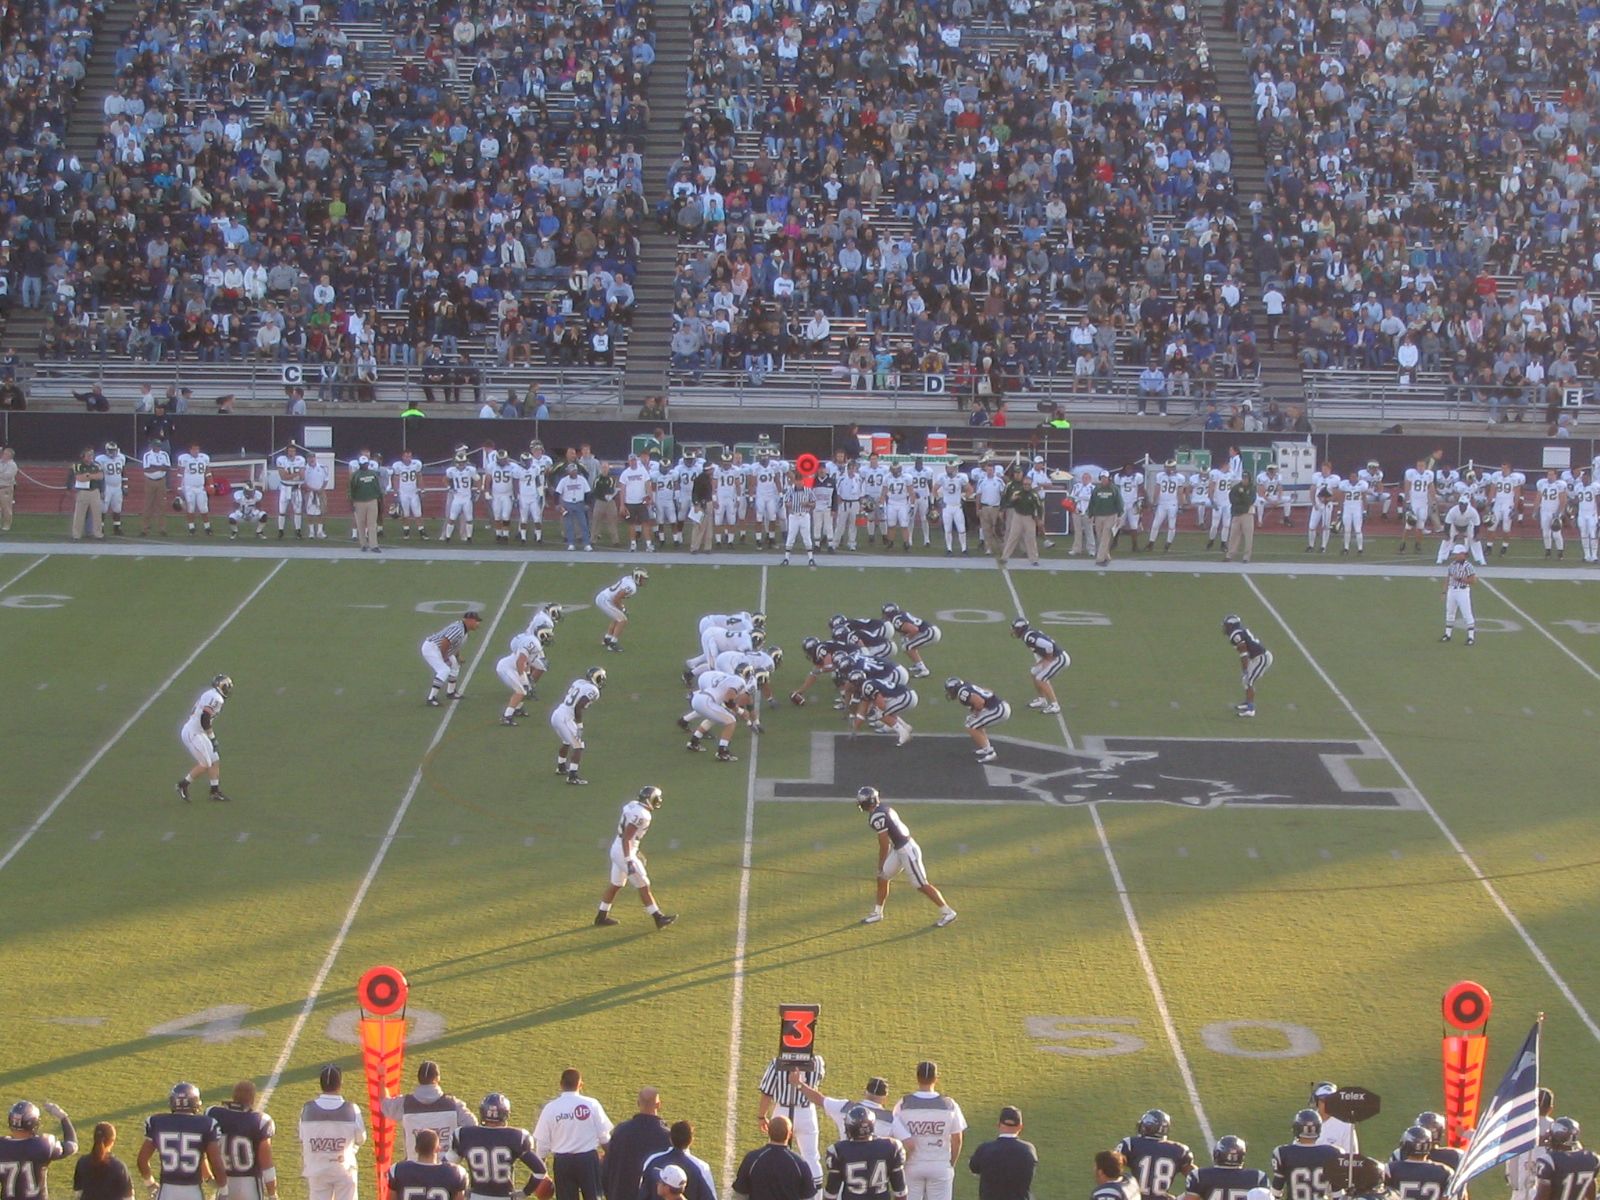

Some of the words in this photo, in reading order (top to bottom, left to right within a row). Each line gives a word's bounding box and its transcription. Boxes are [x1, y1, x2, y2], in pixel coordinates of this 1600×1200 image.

[284, 367, 300, 382] C
[927, 377, 942, 392] D
[1567, 391, 1579, 406] E
[455, 477, 470, 489] 15
[494, 470, 510, 483] 95
[525, 475, 532, 486] 7
[721, 475, 734, 486] 10
[888, 482, 904, 494] 47
[948, 483, 956, 494] 3
[1124, 482, 1132, 492] 5
[1542, 487, 1557, 500] 42
[873, 817, 887, 830] 87
[782, 1010, 815, 1048] 3
[1339, 1091, 1366, 1101] Telex
[907, 1121, 946, 1136] WAC
[160, 1131, 202, 1173] 55
[310, 1137, 346, 1152] WAC
[468, 1146, 512, 1183] 96
[0, 1160, 40, 1198] 71
[846, 1160, 888, 1195] 54
[1138, 1155, 1176, 1196] 18
[1560, 1170, 1595, 1200] 17
